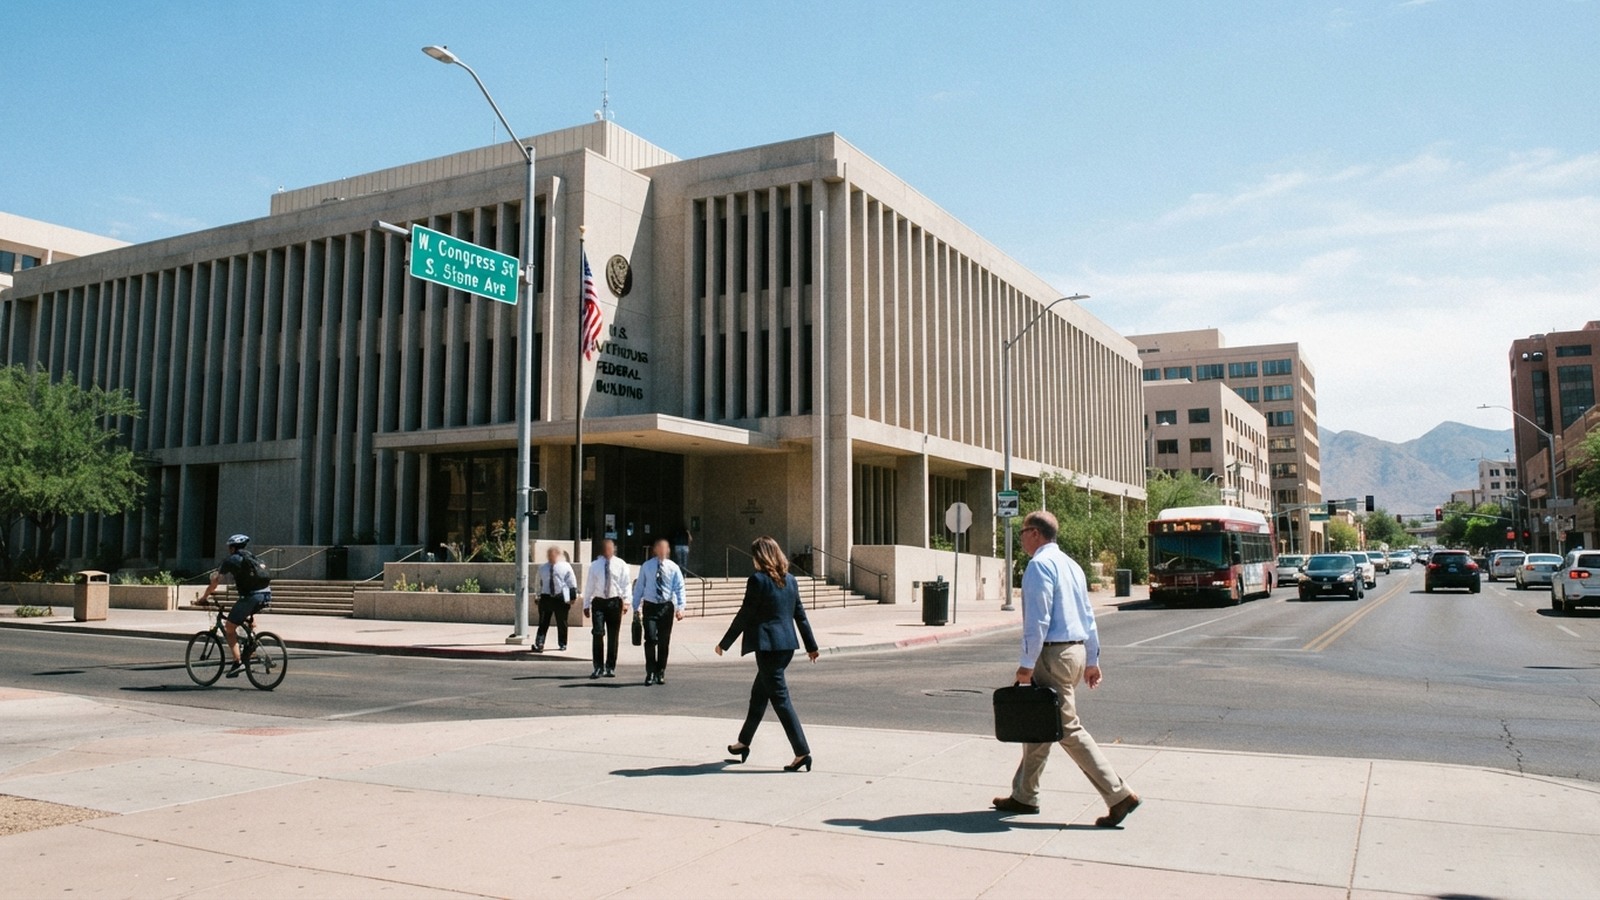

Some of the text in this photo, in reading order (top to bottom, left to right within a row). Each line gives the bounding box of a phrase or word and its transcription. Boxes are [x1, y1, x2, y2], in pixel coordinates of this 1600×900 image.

[418, 231, 432, 252] W.
[438, 239, 496, 272] Congress
[425, 257, 437, 277] S.
[597, 360, 642, 380] FEDERAL
